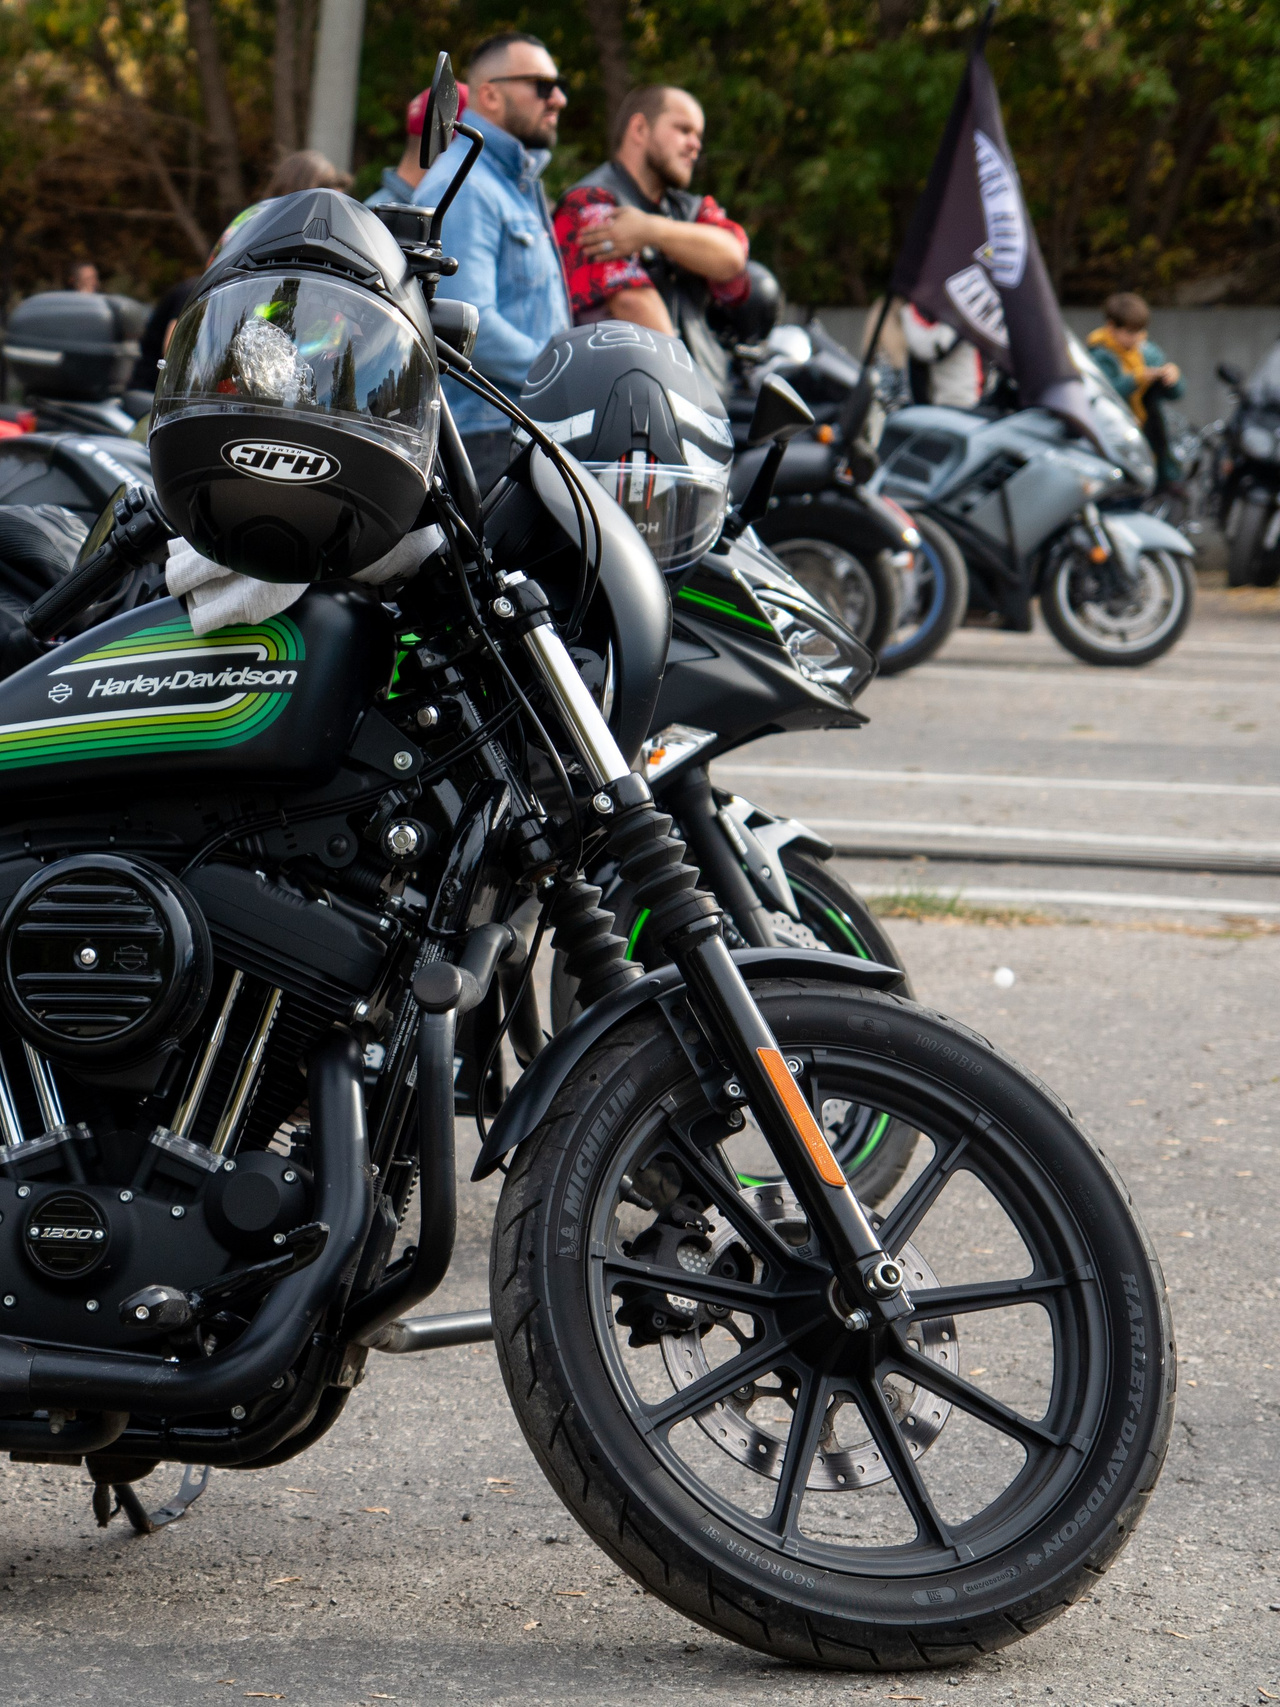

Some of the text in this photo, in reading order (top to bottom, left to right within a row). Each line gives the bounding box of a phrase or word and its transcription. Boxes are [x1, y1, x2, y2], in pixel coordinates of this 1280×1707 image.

[234, 446, 326, 476] HJC
[260, 445, 302, 455] HELMETS
[87, 667, 298, 698] Harley-Davidson
[912, 1033, 959, 1063] 100/90
[563, 1080, 637, 1219] MICHELIN
[40, 1227, 93, 1240] 1200
[1042, 1271, 1147, 1559] HARLEY-DAVIDSON
[726, 1539, 816, 1589] SCORCHER
